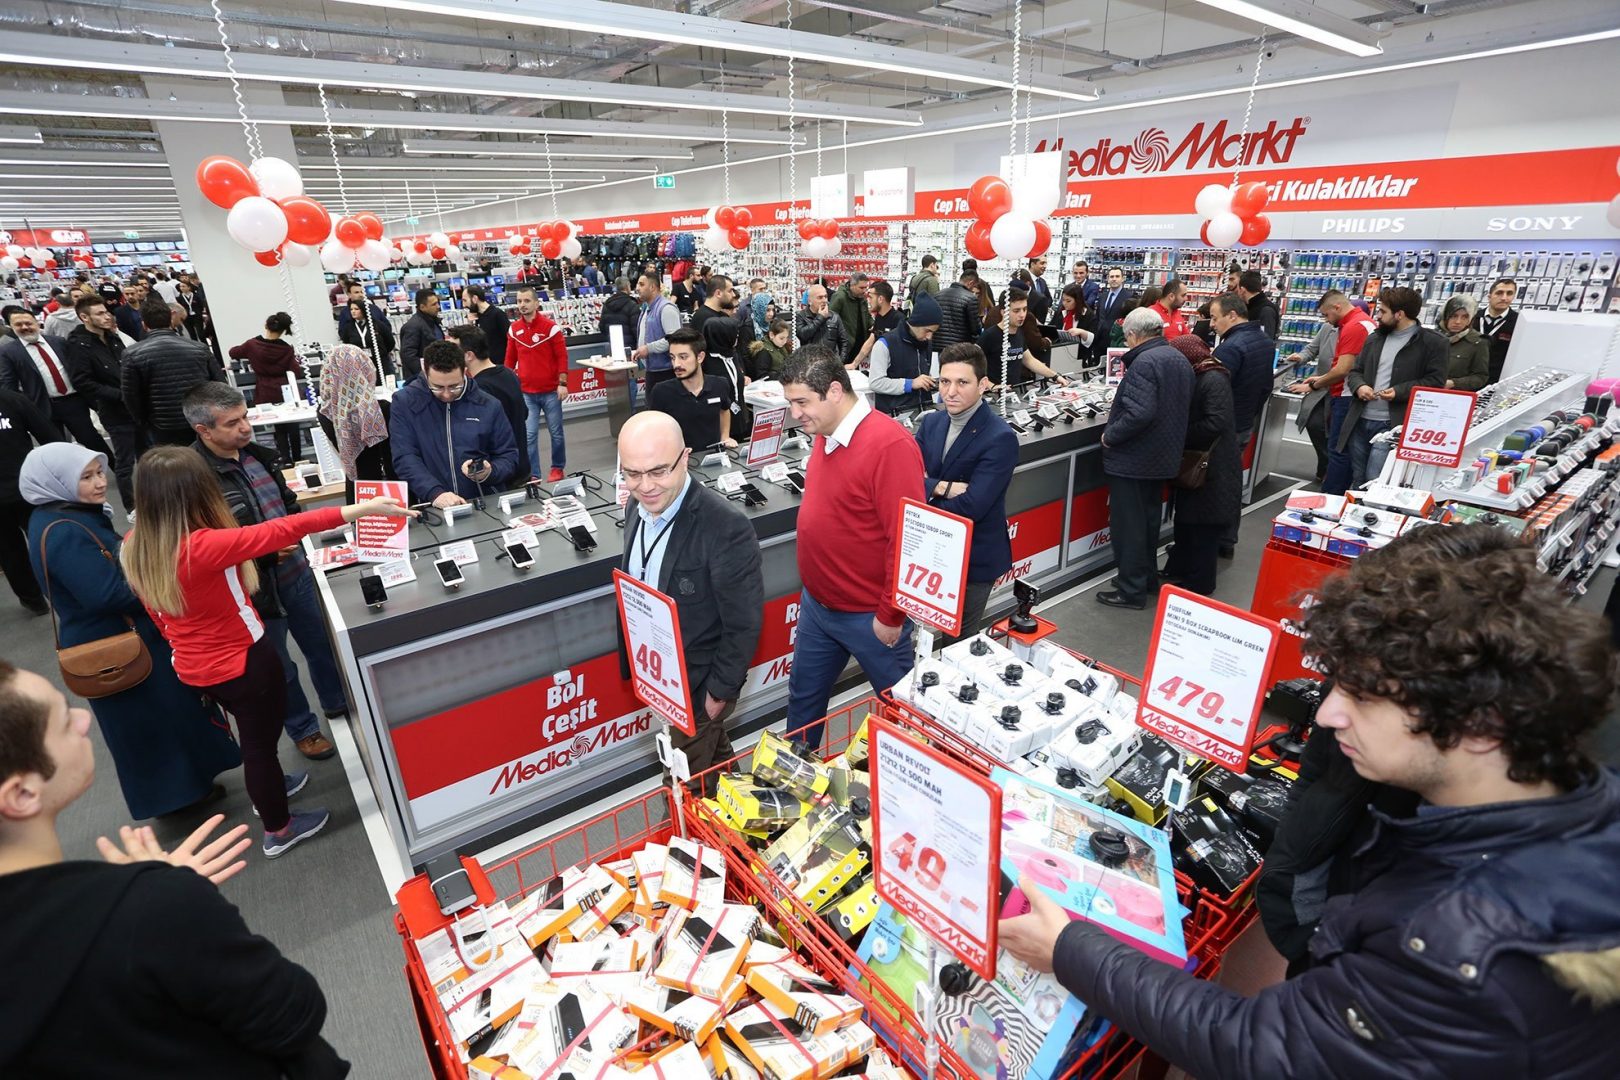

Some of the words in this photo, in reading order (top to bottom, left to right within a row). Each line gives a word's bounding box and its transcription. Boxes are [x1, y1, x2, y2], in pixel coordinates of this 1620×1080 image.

[1034, 138, 1133, 177] edia
[1160, 117, 1306, 172] Markt
[933, 198, 953, 215] Cep
[1282, 174, 1418, 203] Kulaklıklar
[788, 206, 812, 220] Telefo
[1321, 217, 1405, 233] PHILIPS
[1487, 216, 1583, 232] SONY
[1408, 428, 1457, 447] 599.-
[904, 562, 956, 600] 179.-
[897, 595, 923, 615] Media
[1167, 612, 1181, 622] MINI
[1186, 618, 1198, 628] BOX
[1198, 623, 1232, 642] SCRAPBOOK
[1244, 640, 1265, 653] GREEN
[636, 643, 679, 689] 49.-
[547, 674, 584, 710] Bol
[1157, 675, 1244, 727] 479.-
[541, 697, 598, 743] Çeşit
[1142, 712, 1187, 738] Media
[1197, 739, 1242, 765] Markt
[489, 750, 570, 795] Media
[588, 712, 653, 753] Markt
[879, 740, 904, 763] URBAN
[905, 755, 932, 776] REVOLT
[923, 779, 943, 797] MAH
[888, 831, 980, 914] 49.-
[880, 880, 927, 920] Media
[939, 926, 988, 968] Markt
